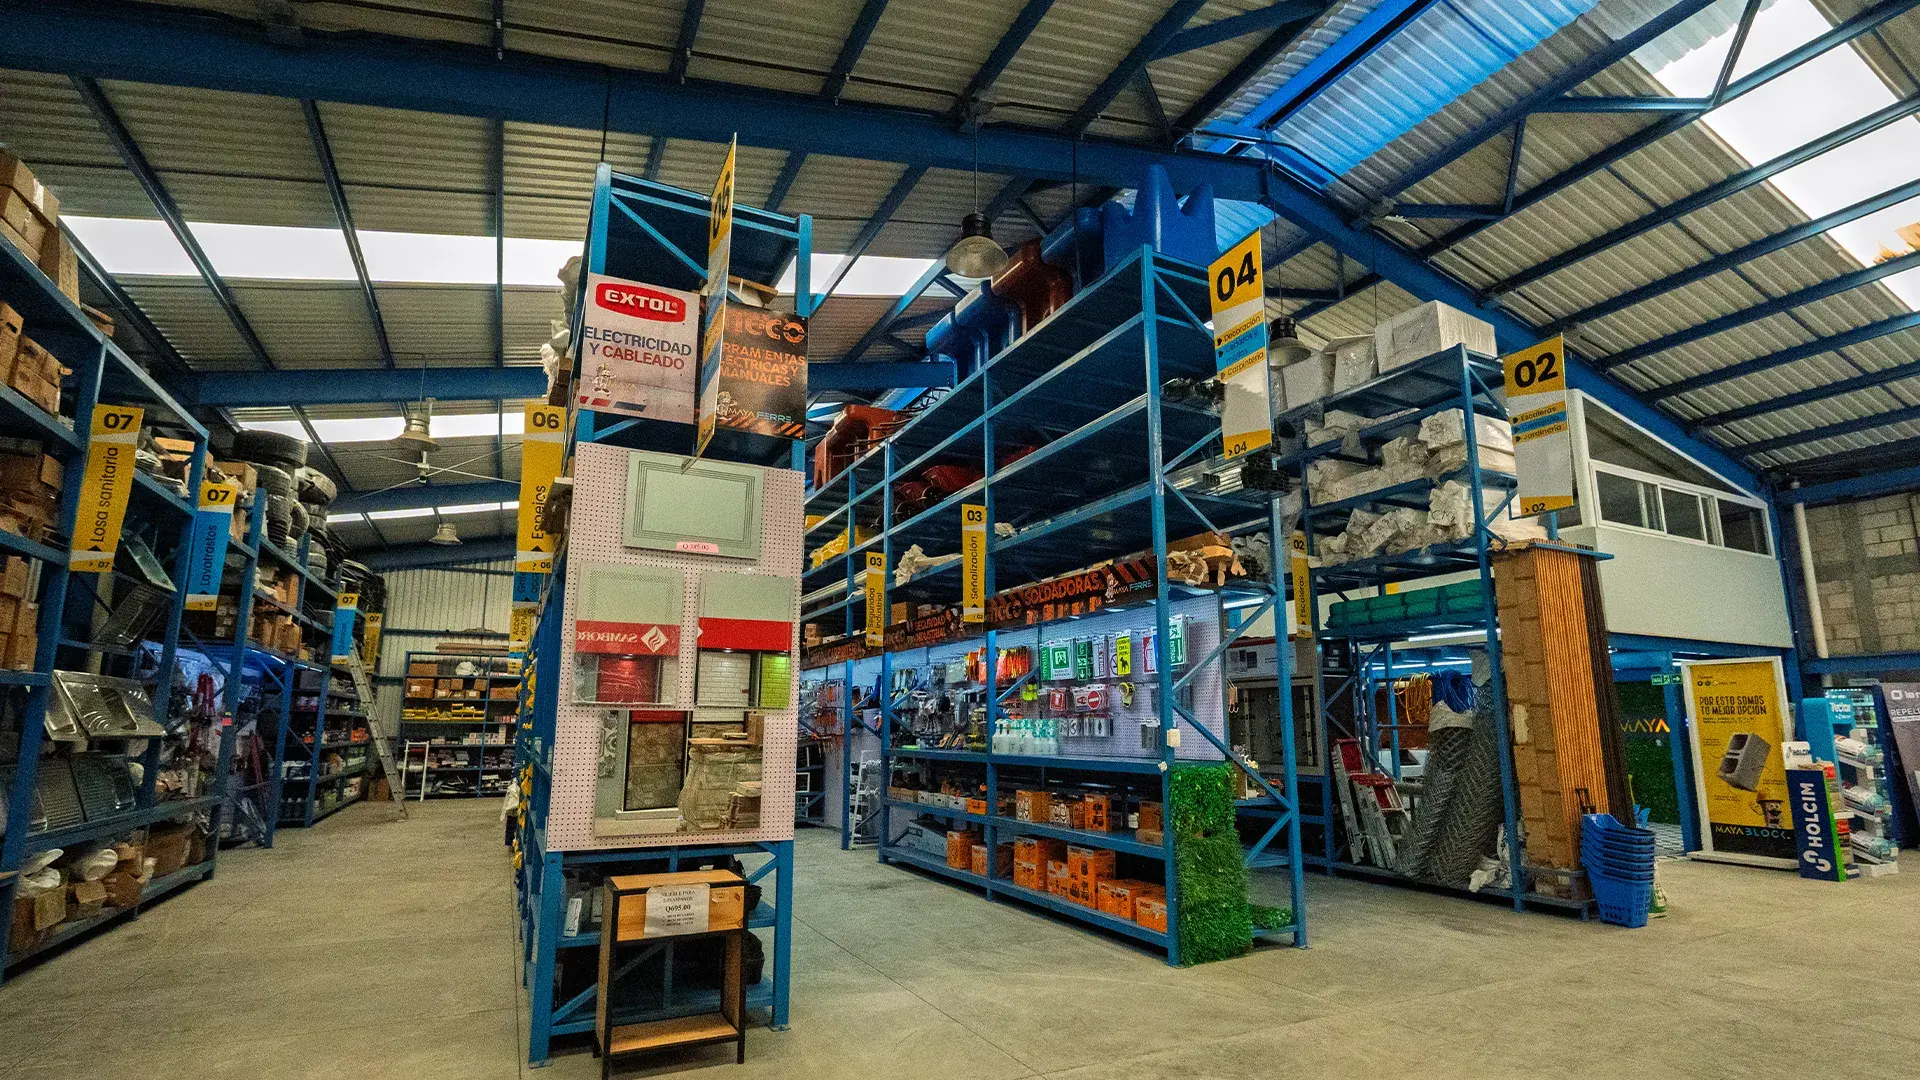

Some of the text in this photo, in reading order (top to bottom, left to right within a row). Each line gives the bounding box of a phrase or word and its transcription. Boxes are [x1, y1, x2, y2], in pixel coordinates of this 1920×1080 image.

[713, 170, 730, 240] 06
[1217, 251, 1257, 302] 04
[605, 289, 677, 314] EXTOL
[1224, 316, 1261, 341] Decoración
[584, 325, 691, 356] ELECTRICIDAD
[589, 342, 685, 370] Y CABLEADO
[720, 366, 791, 387] MANUALES
[790, 366, 799, 376] Y
[1514, 351, 1558, 388] 02
[728, 407, 755, 418] MAYA
[1520, 406, 1557, 422] Escaleras
[103, 412, 134, 430] 07
[532, 412, 560, 429] 06
[1234, 441, 1247, 456] 04
[99, 447, 119, 507] sanitaria
[207, 489, 230, 502] 07
[1532, 503, 1545, 513] 02
[967, 510, 982, 522] 03
[1293, 540, 1304, 550] 02
[97, 561, 110, 569] 07
[540, 561, 551, 569] 06
[869, 556, 882, 567] 03
[1024, 572, 1101, 605] SOLDADORAS
[342, 596, 354, 604] 07
[1699, 695, 1764, 705] POR ESTO SOMOS
[1701, 706, 1710, 715] TU
[1712, 706, 1735, 715] MEJOR
[1621, 718, 1670, 733] MAYA
[1800, 782, 1823, 848] HOLCIM
[665, 904, 691, 913] Q695.00
